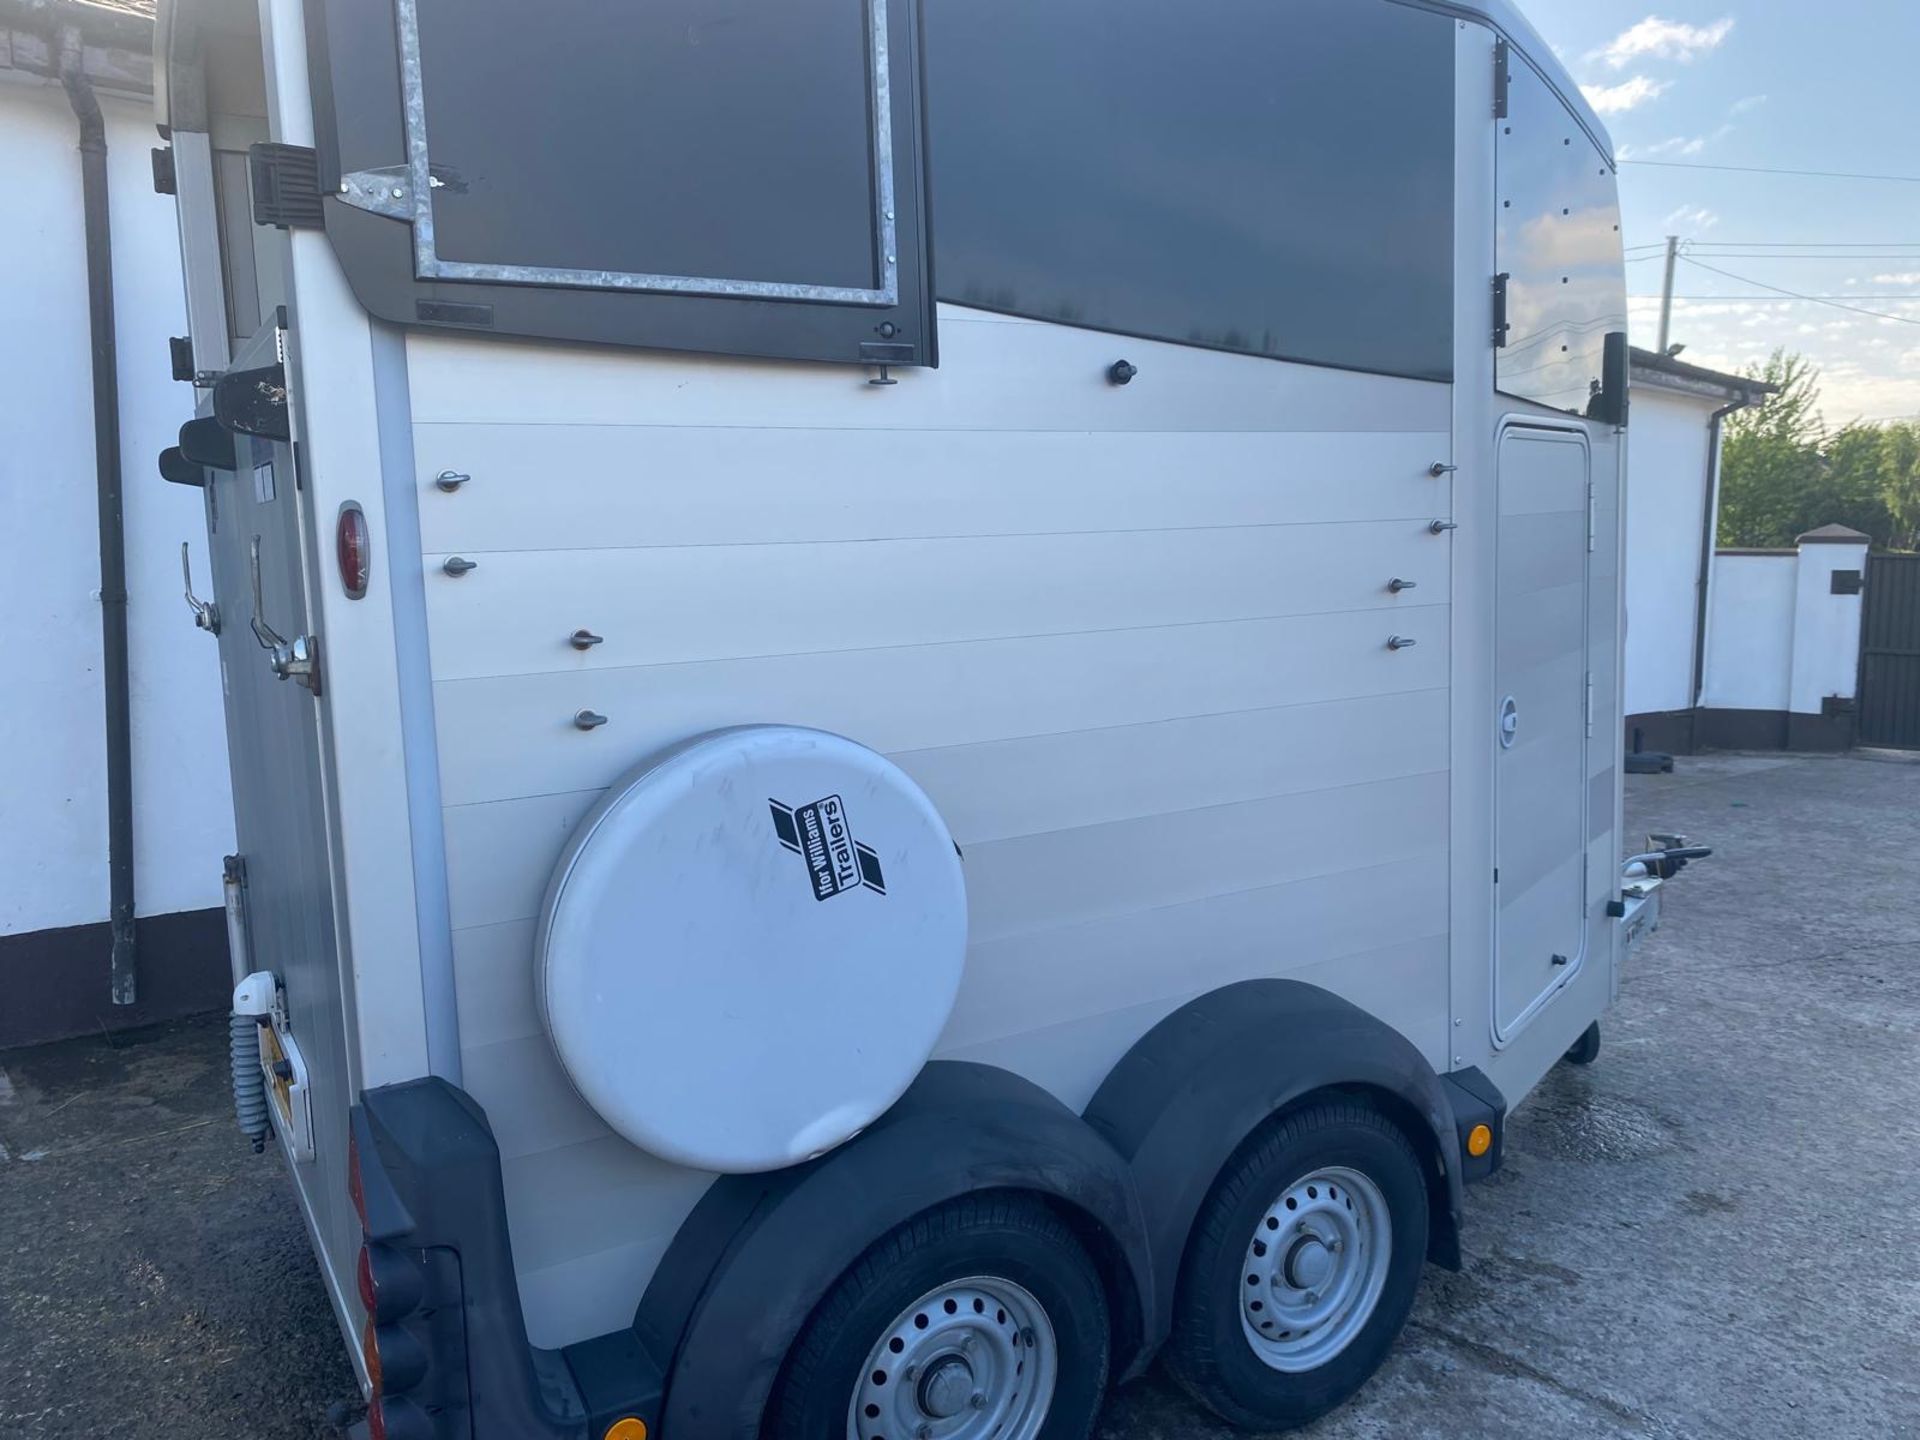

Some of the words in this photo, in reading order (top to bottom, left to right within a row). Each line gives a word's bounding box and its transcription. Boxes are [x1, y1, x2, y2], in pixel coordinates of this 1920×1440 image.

[803, 808, 827, 871] Williams
[824, 800, 854, 887] Trailers
[818, 870, 834, 896] Ifor
